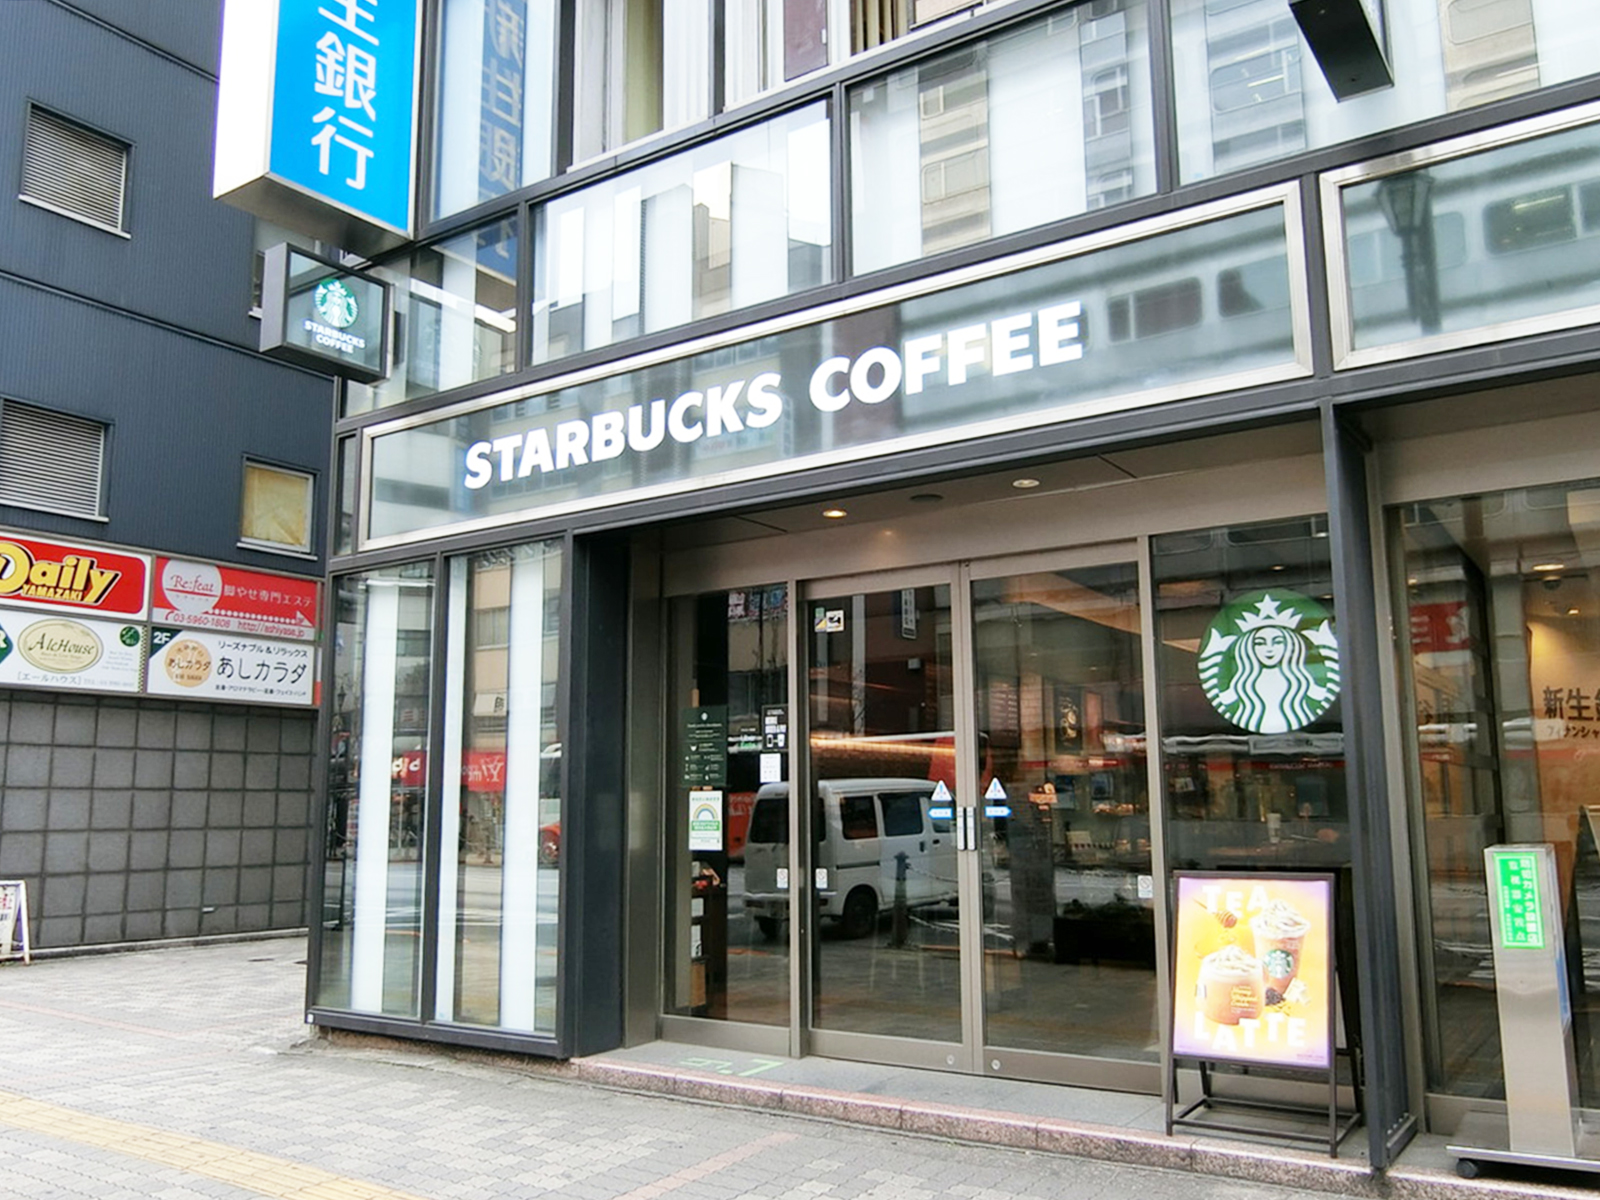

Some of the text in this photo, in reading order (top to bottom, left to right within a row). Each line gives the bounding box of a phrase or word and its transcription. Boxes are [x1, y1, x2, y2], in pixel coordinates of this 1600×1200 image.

[303, 319, 366, 349] STARBUCKS
[315, 333, 354, 354] COFFEE
[463, 300, 1084, 491] STARBUCKS COFFEE
[22, 583, 84, 602] YAMAZAKI
[223, 584, 312, 607] 脚やせ専門エステ
[153, 631, 172, 645] 2F
[216, 656, 308, 685] あしカラダ
[1202, 884, 1269, 918] TEA
[1194, 1011, 1307, 1051] LATTE
